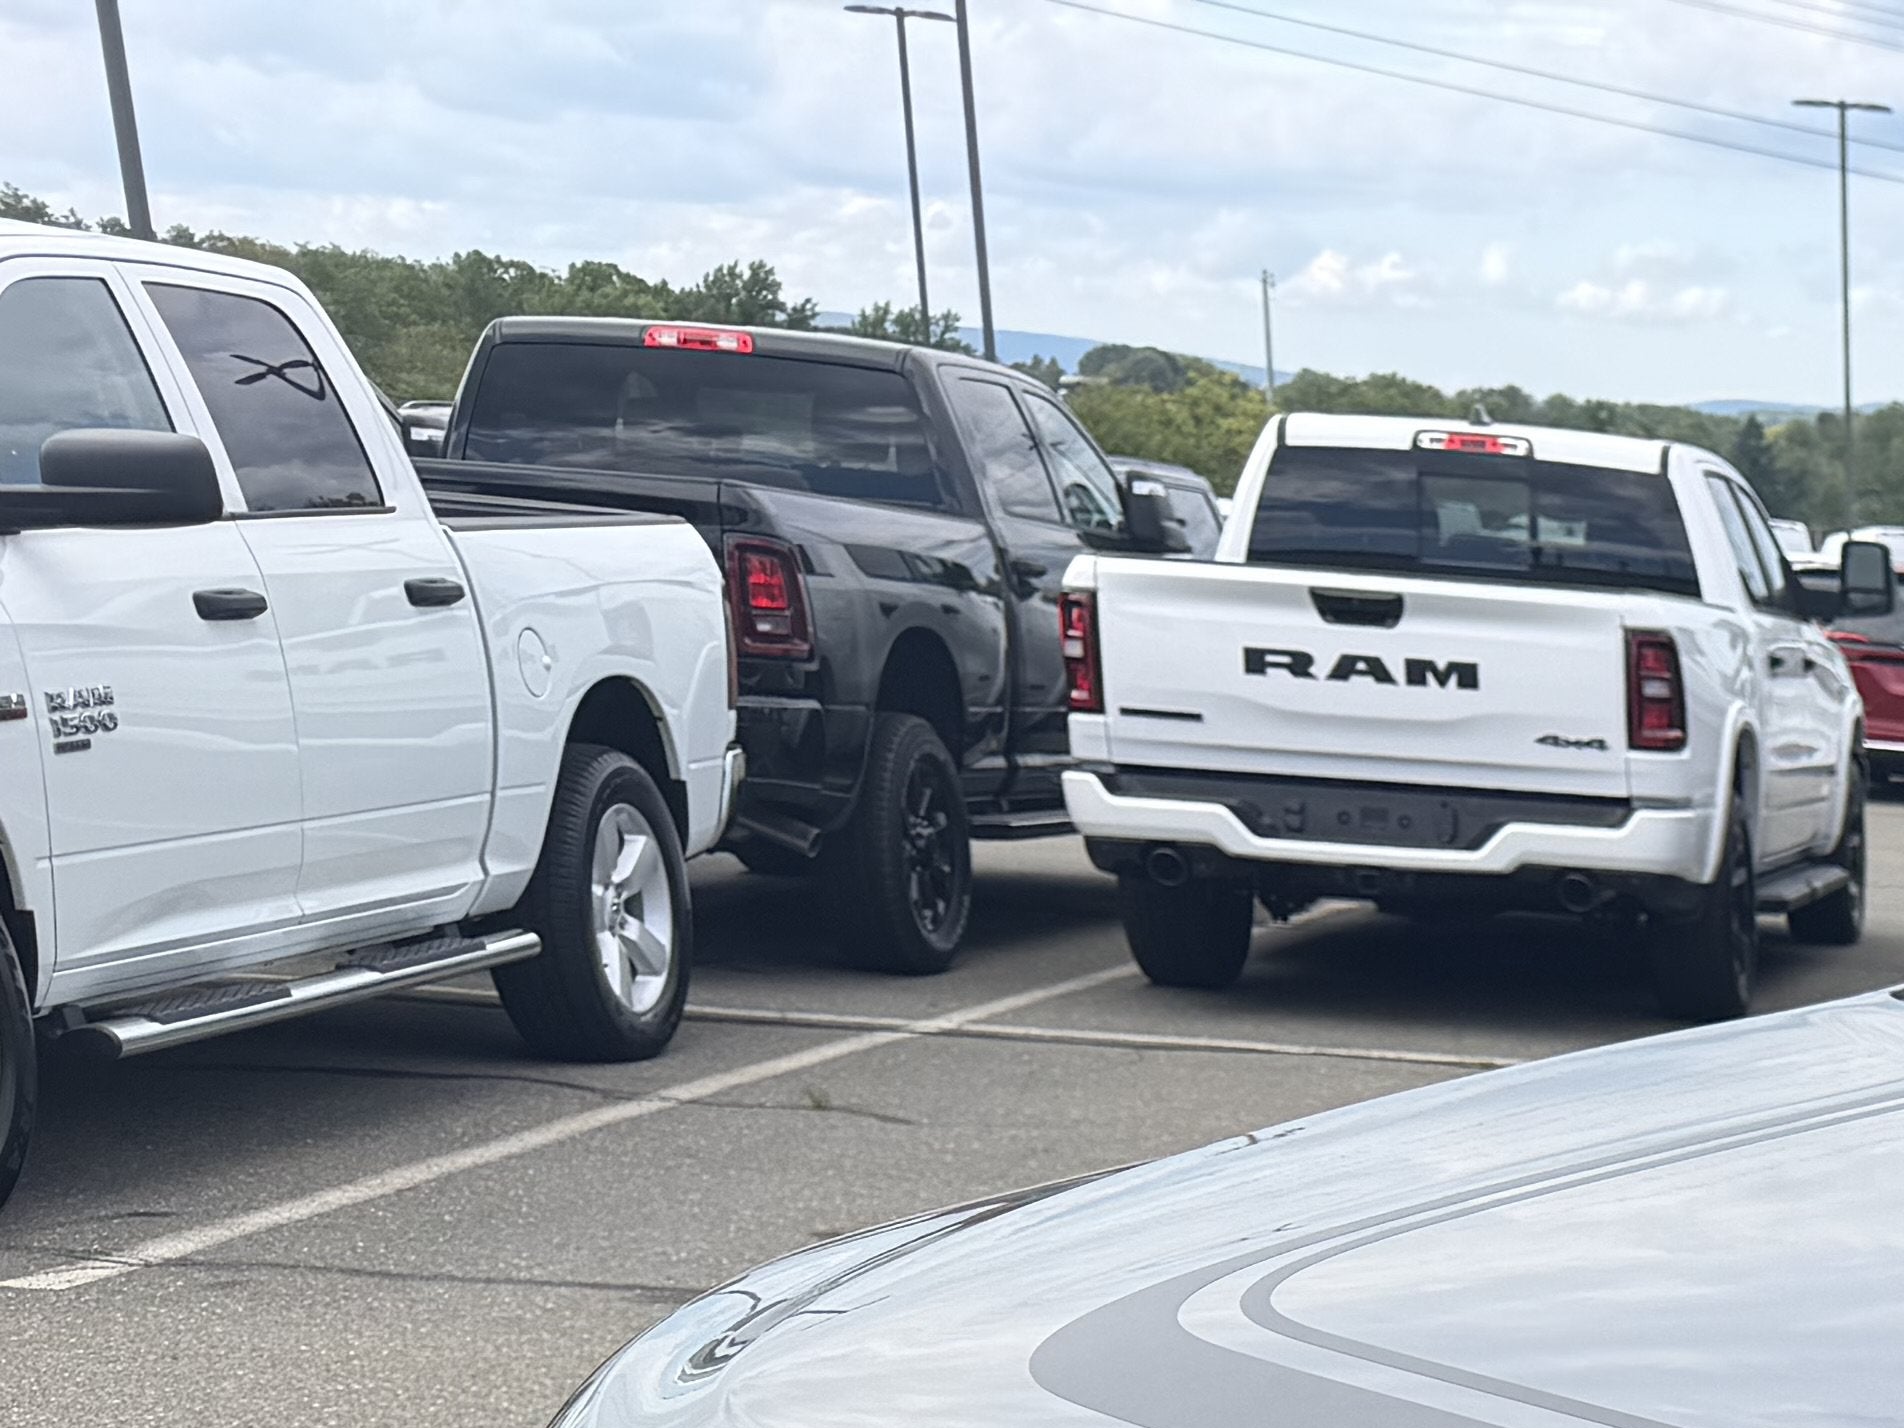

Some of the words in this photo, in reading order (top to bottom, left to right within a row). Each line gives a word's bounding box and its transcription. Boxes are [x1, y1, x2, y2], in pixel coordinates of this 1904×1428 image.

[1242, 646, 1480, 691] RAM
[44, 684, 116, 714] RAM
[48, 708, 119, 739] 1500
